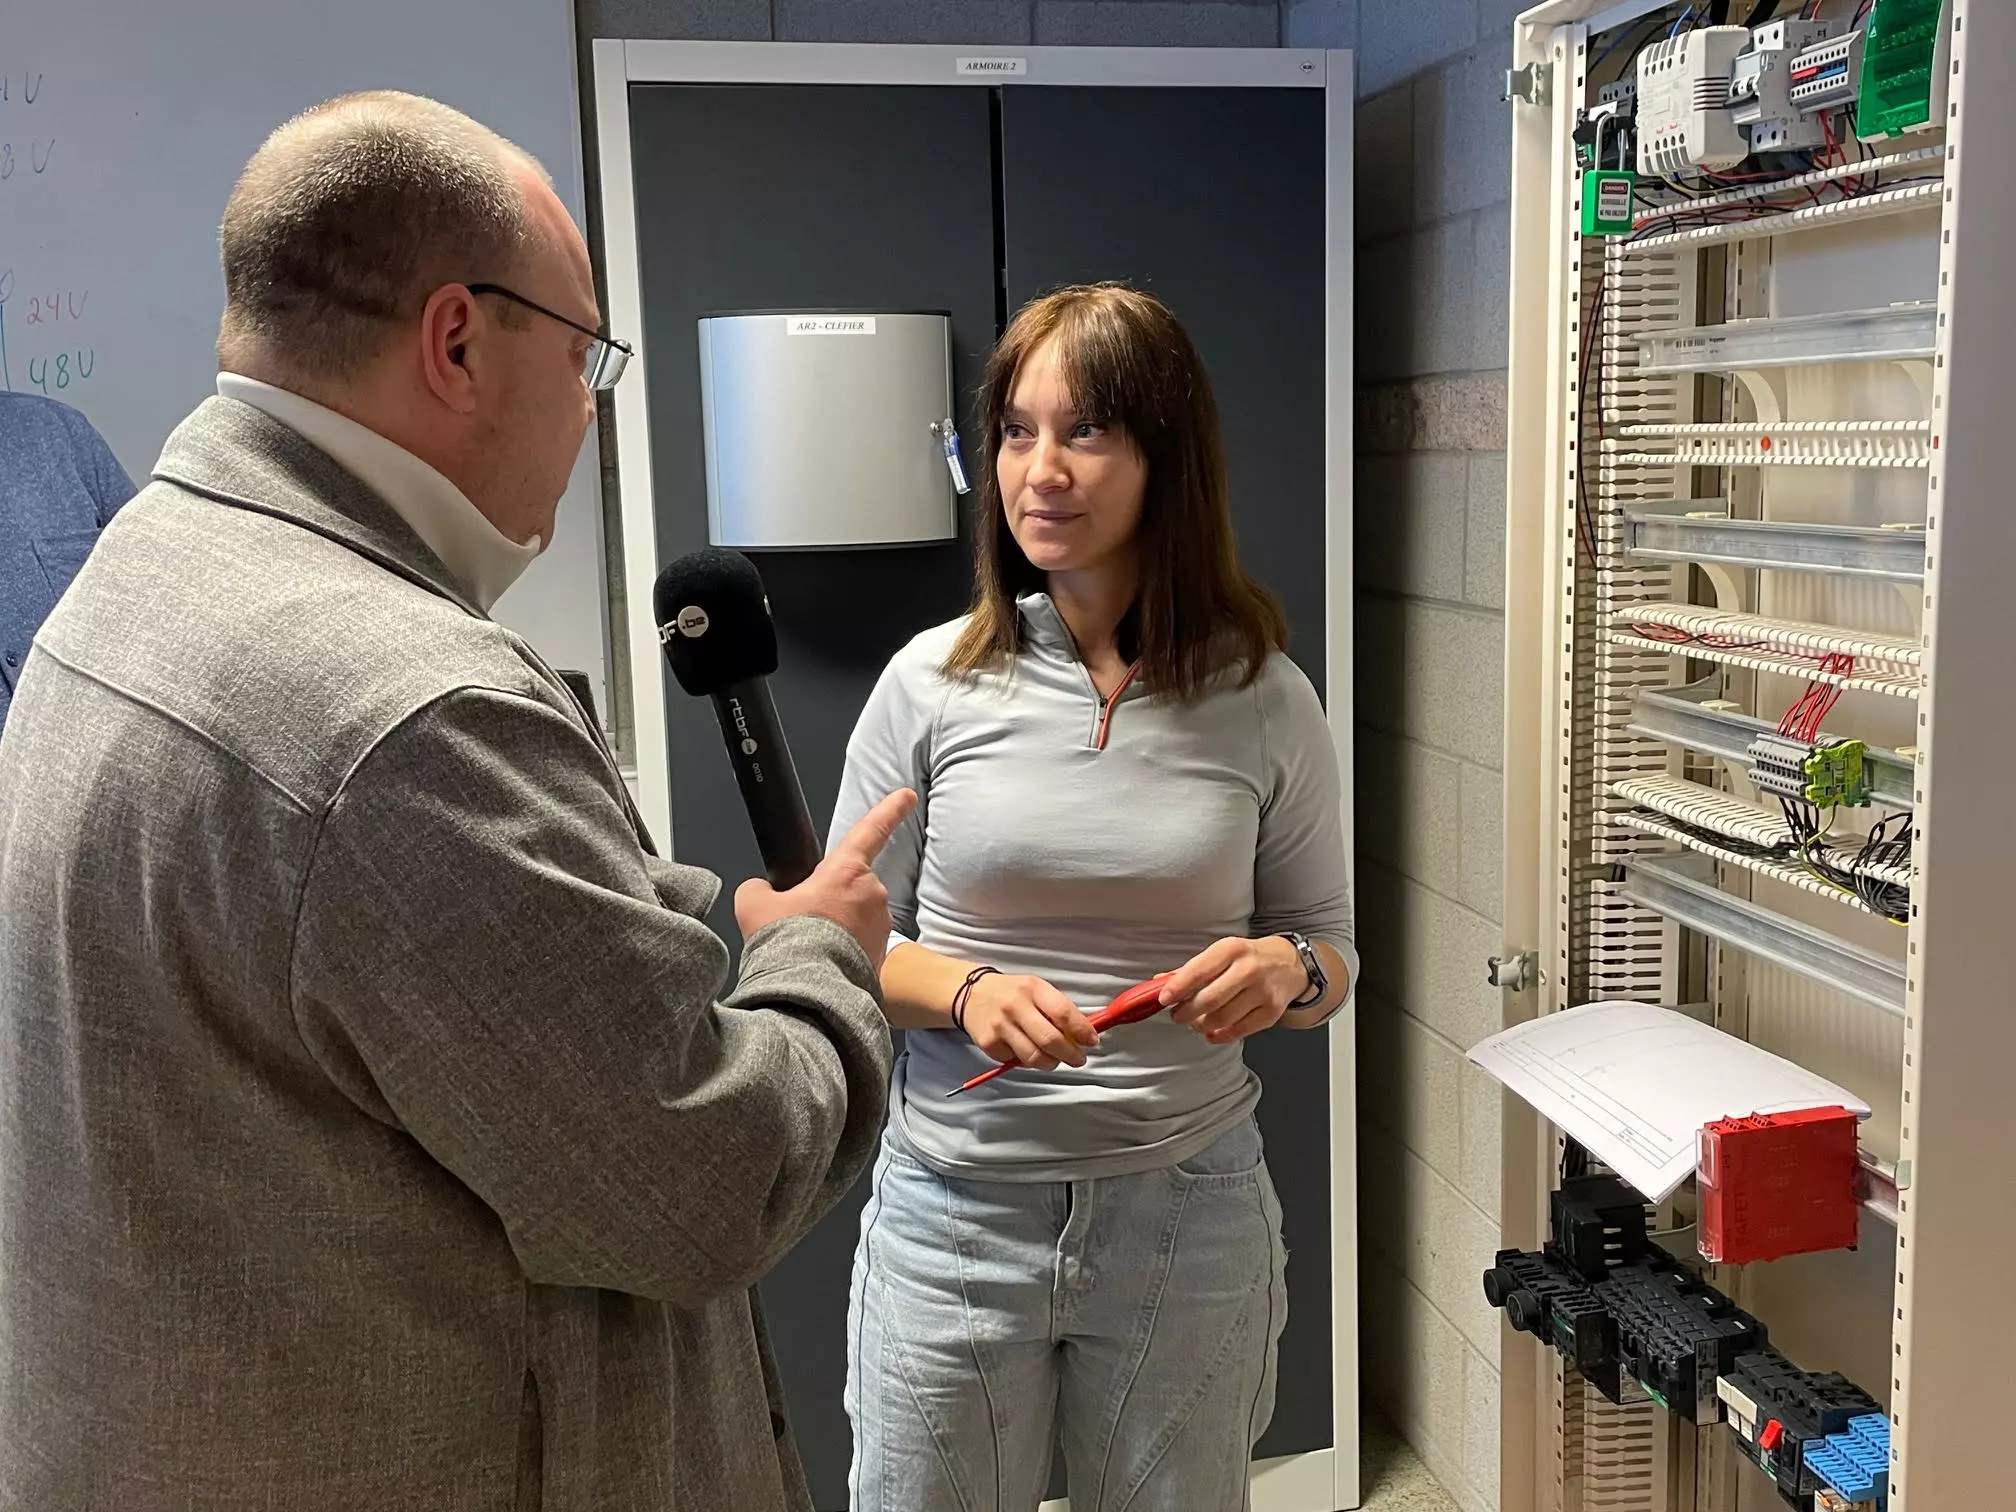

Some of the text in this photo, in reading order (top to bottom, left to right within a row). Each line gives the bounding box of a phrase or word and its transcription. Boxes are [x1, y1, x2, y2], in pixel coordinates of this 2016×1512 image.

[965, 62, 1017, 71] ARMOIRE 2
[797, 321, 817, 330] AR2
